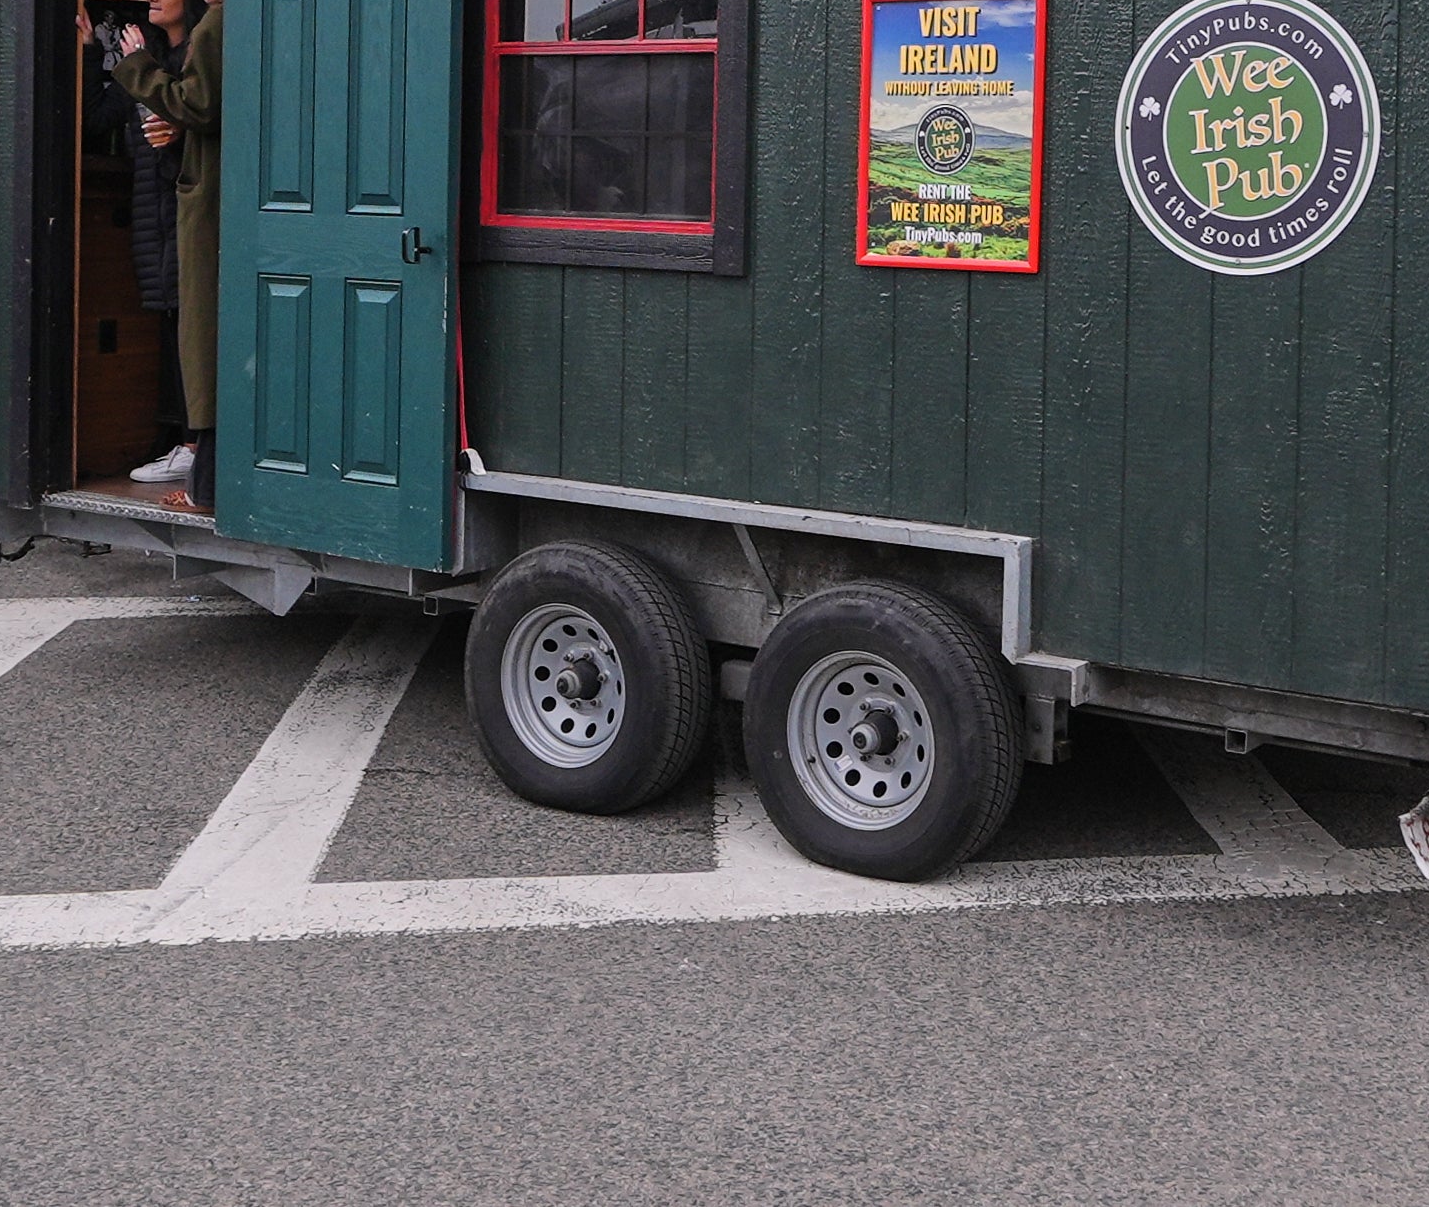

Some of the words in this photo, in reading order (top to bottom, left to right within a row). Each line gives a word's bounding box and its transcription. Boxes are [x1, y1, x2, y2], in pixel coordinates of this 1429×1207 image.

[919, 6, 981, 38] VISIT
[1164, 11, 1324, 65] TinyPubs.com
[900, 44, 998, 75] IRELAND
[1190, 50, 1296, 100] Wee
[885, 81, 931, 96] WITHOUT
[933, 81, 980, 97] LEAVING
[982, 81, 1014, 96] HOME
[933, 118, 958, 132] Wee
[1189, 97, 1303, 154] Irish
[931, 131, 960, 147] Irish
[934, 145, 960, 161] Pub
[918, 184, 947, 200] RENT
[950, 185, 972, 200] THE
[1141, 155, 1169, 195] Let
[1165, 195, 1198, 229] the
[1200, 222, 1261, 247] good
[1268, 198, 1330, 244] times
[1326, 147, 1353, 194] roll
[1199, 151, 1304, 219] Pub
[891, 202, 922, 223] WEE
[924, 202, 967, 224] IRISH
[970, 204, 1004, 225] PUB
[904, 226, 983, 245] TinyPubs.com
